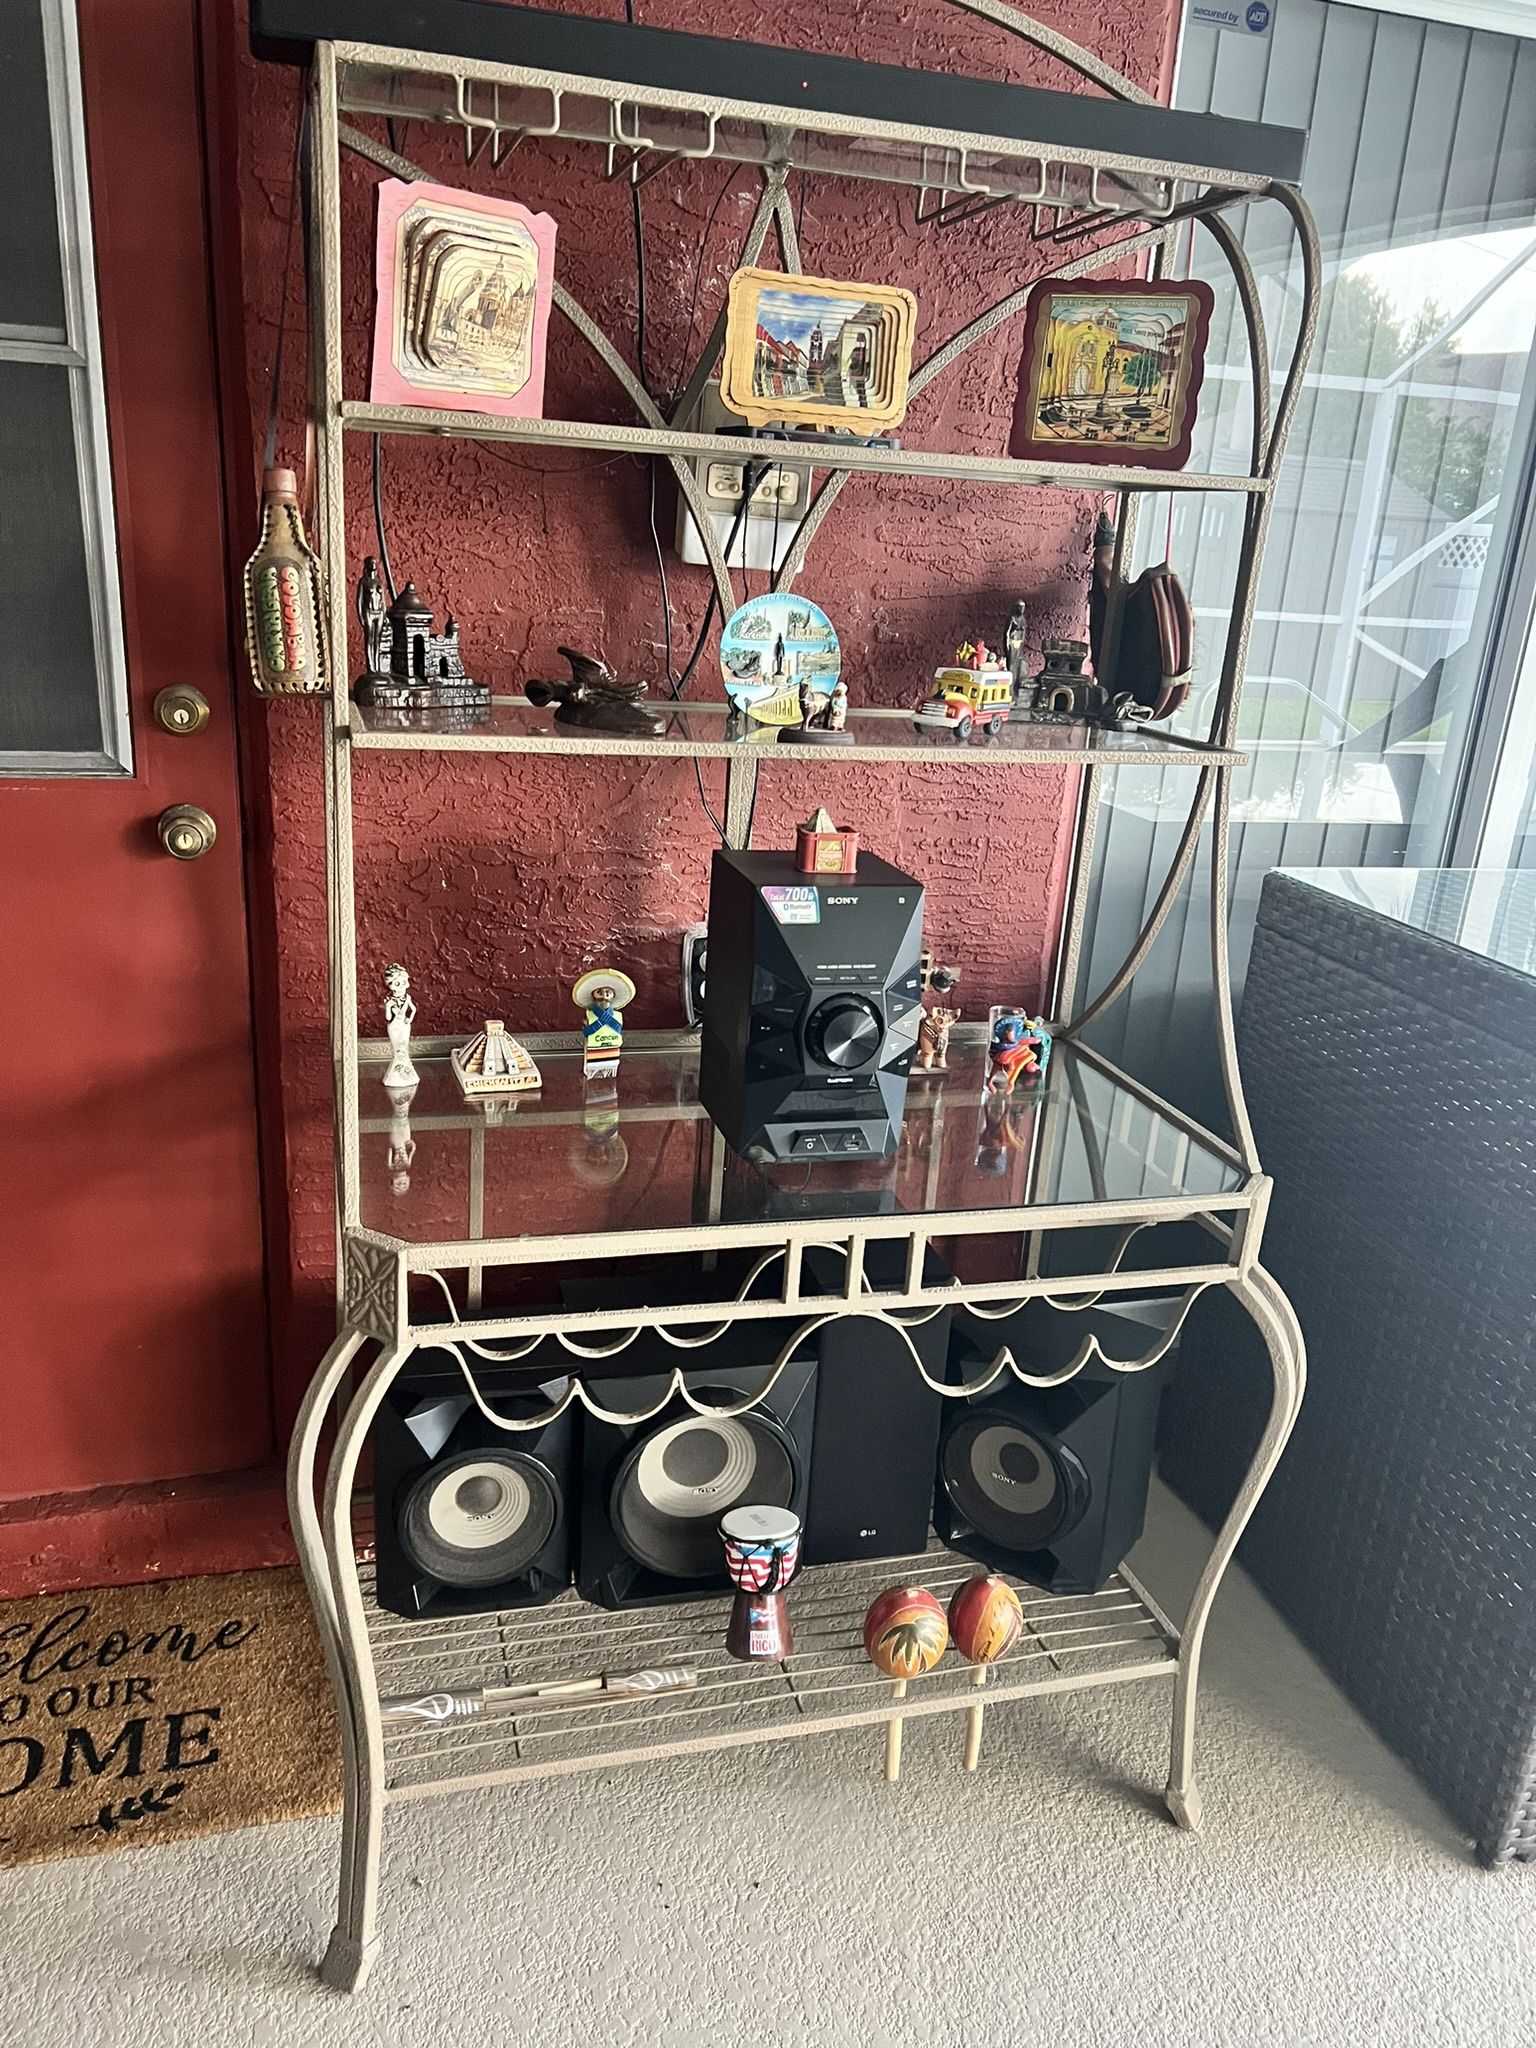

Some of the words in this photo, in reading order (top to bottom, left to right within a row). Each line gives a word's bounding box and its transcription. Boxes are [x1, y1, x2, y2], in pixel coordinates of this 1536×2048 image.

[1193, 7, 1228, 19] secured
[1229, 10, 1239, 22] by
[1249, 8, 1267, 23] ADT
[280, 566, 306, 672] COLOMBIA
[827, 897, 858, 905] SONY
[992, 1472, 1017, 1486] SONY
[752, 1640, 776, 1652] RICO
[46, 1678, 155, 1718] OUR
